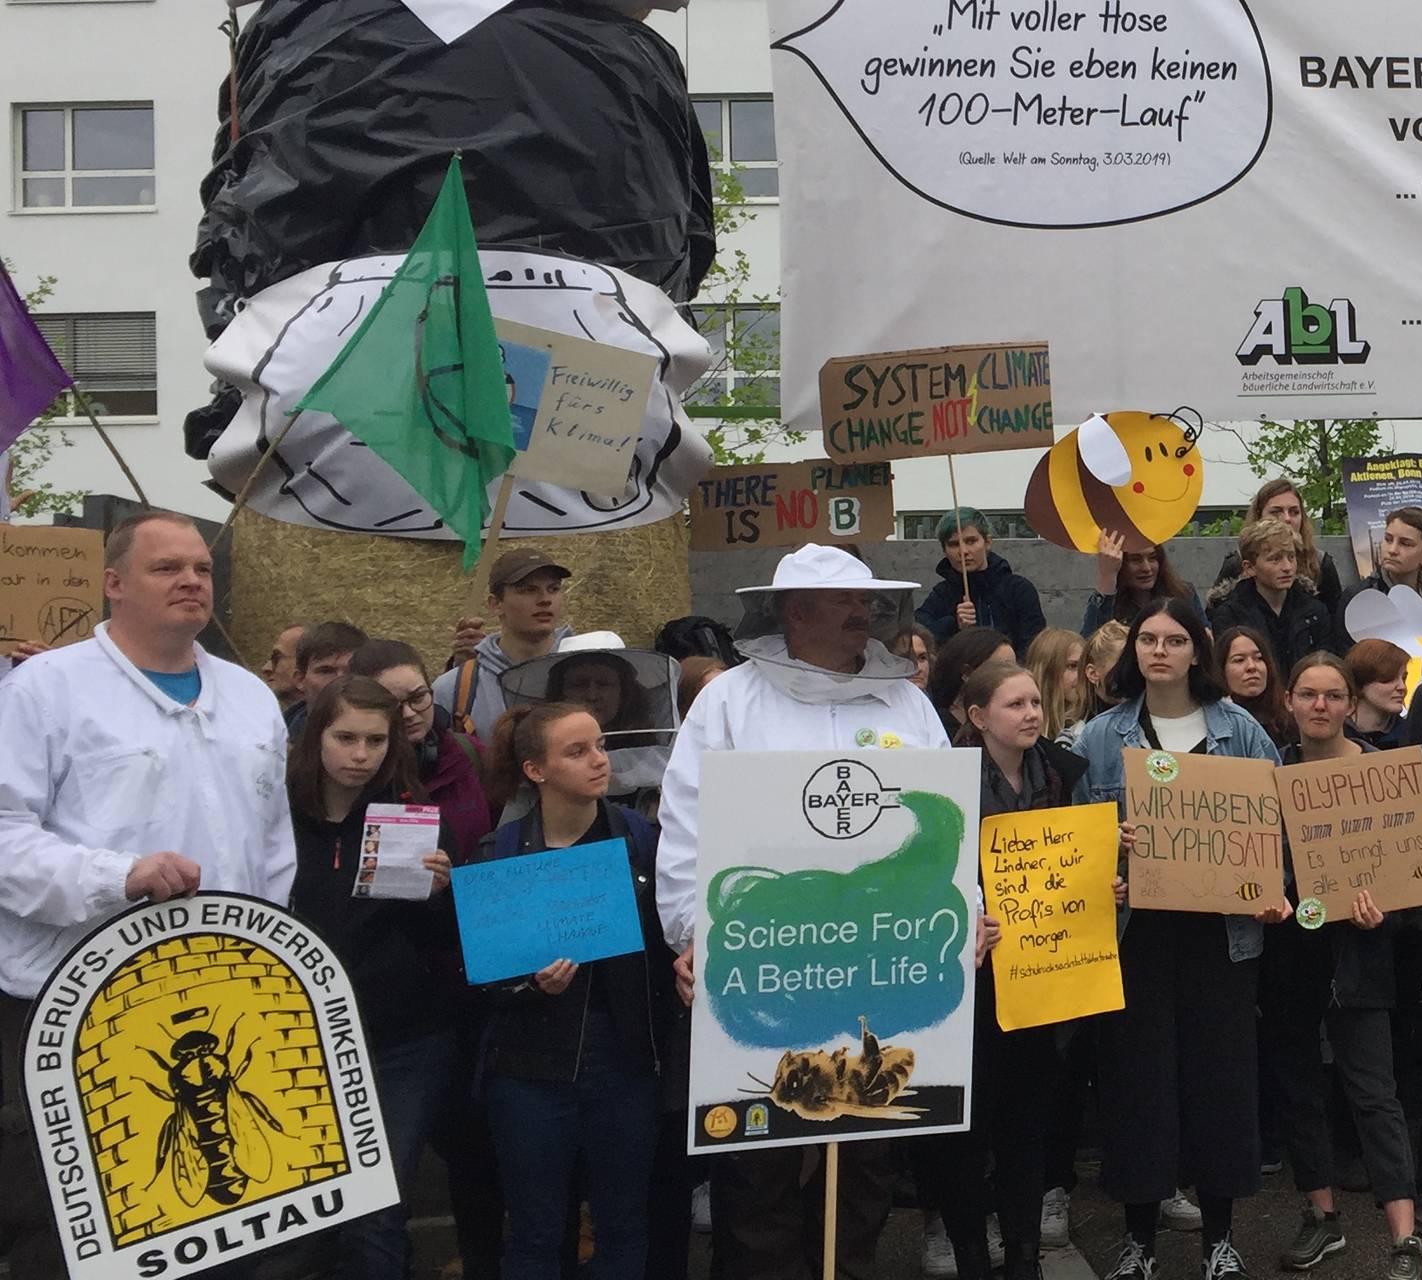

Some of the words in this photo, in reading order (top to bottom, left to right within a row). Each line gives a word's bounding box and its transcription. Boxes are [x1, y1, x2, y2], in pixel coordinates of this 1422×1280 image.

[1010, 0, 1086, 33] voller
[1100, 1, 1168, 34] Hose
[861, 46, 997, 95] gewinnen
[1010, 46, 1056, 80] Sie
[1069, 49, 1137, 80] eben
[1151, 47, 1238, 82] keinen
[1003, 152, 1026, 166] Welt
[1031, 156, 1047, 165] am
[1050, 152, 1099, 172] Sonntag,
[551, 365, 635, 402] Freiwillig
[843, 363, 967, 411] SYSTEM
[975, 350, 1051, 390] CLIMATE
[1242, 370, 1335, 382] Arbeitsgemeinschaft
[1242, 380, 1290, 392] bäuerliche
[1292, 379, 1358, 392] Landwirtschaft
[555, 392, 606, 415] fürs
[977, 401, 1053, 435] CHANGE
[546, 417, 631, 452] Klima!
[828, 411, 931, 454] CHANGE,
[932, 398, 973, 443] NOT
[811, 462, 891, 491] PLANET
[1366, 458, 1417, 473] Angeklagt:
[1398, 469, 1422, 479] Bonn
[698, 473, 778, 510] THERE
[775, 488, 819, 532] NO
[834, 499, 857, 530] B
[2, 531, 87, 560] kommen
[725, 510, 760, 546] IS
[37, 572, 50, 586] in
[62, 568, 89, 589] den
[808, 792, 880, 809] BAYER
[1130, 785, 1176, 822] WIR
[1291, 761, 1422, 813] GLYPHOSAT
[990, 827, 1039, 854] Lieber
[1042, 826, 1076, 848] Herr
[1132, 823, 1282, 870] GLYPHOSATT
[1307, 849, 1325, 869] Es
[1340, 837, 1387, 868] bringt
[993, 855, 1052, 874] Lindner,
[1059, 848, 1085, 869] wir
[994, 875, 1029, 897] sind
[1044, 871, 1067, 891] die
[1312, 874, 1339, 896] alle
[117, 906, 191, 947] UND
[999, 898, 1055, 929] Profis
[1061, 898, 1086, 915] von
[200, 902, 336, 996] ERWERBS-
[723, 919, 859, 951] Science
[871, 912, 926, 943] For
[721, 966, 747, 997] A
[757, 961, 859, 994] Better
[36, 946, 115, 1073] BERUFS-
[323, 995, 382, 1169] IMKERBUND
[40, 1084, 102, 1262] DEUTSCHER
[136, 1188, 345, 1279] SOLTAU
